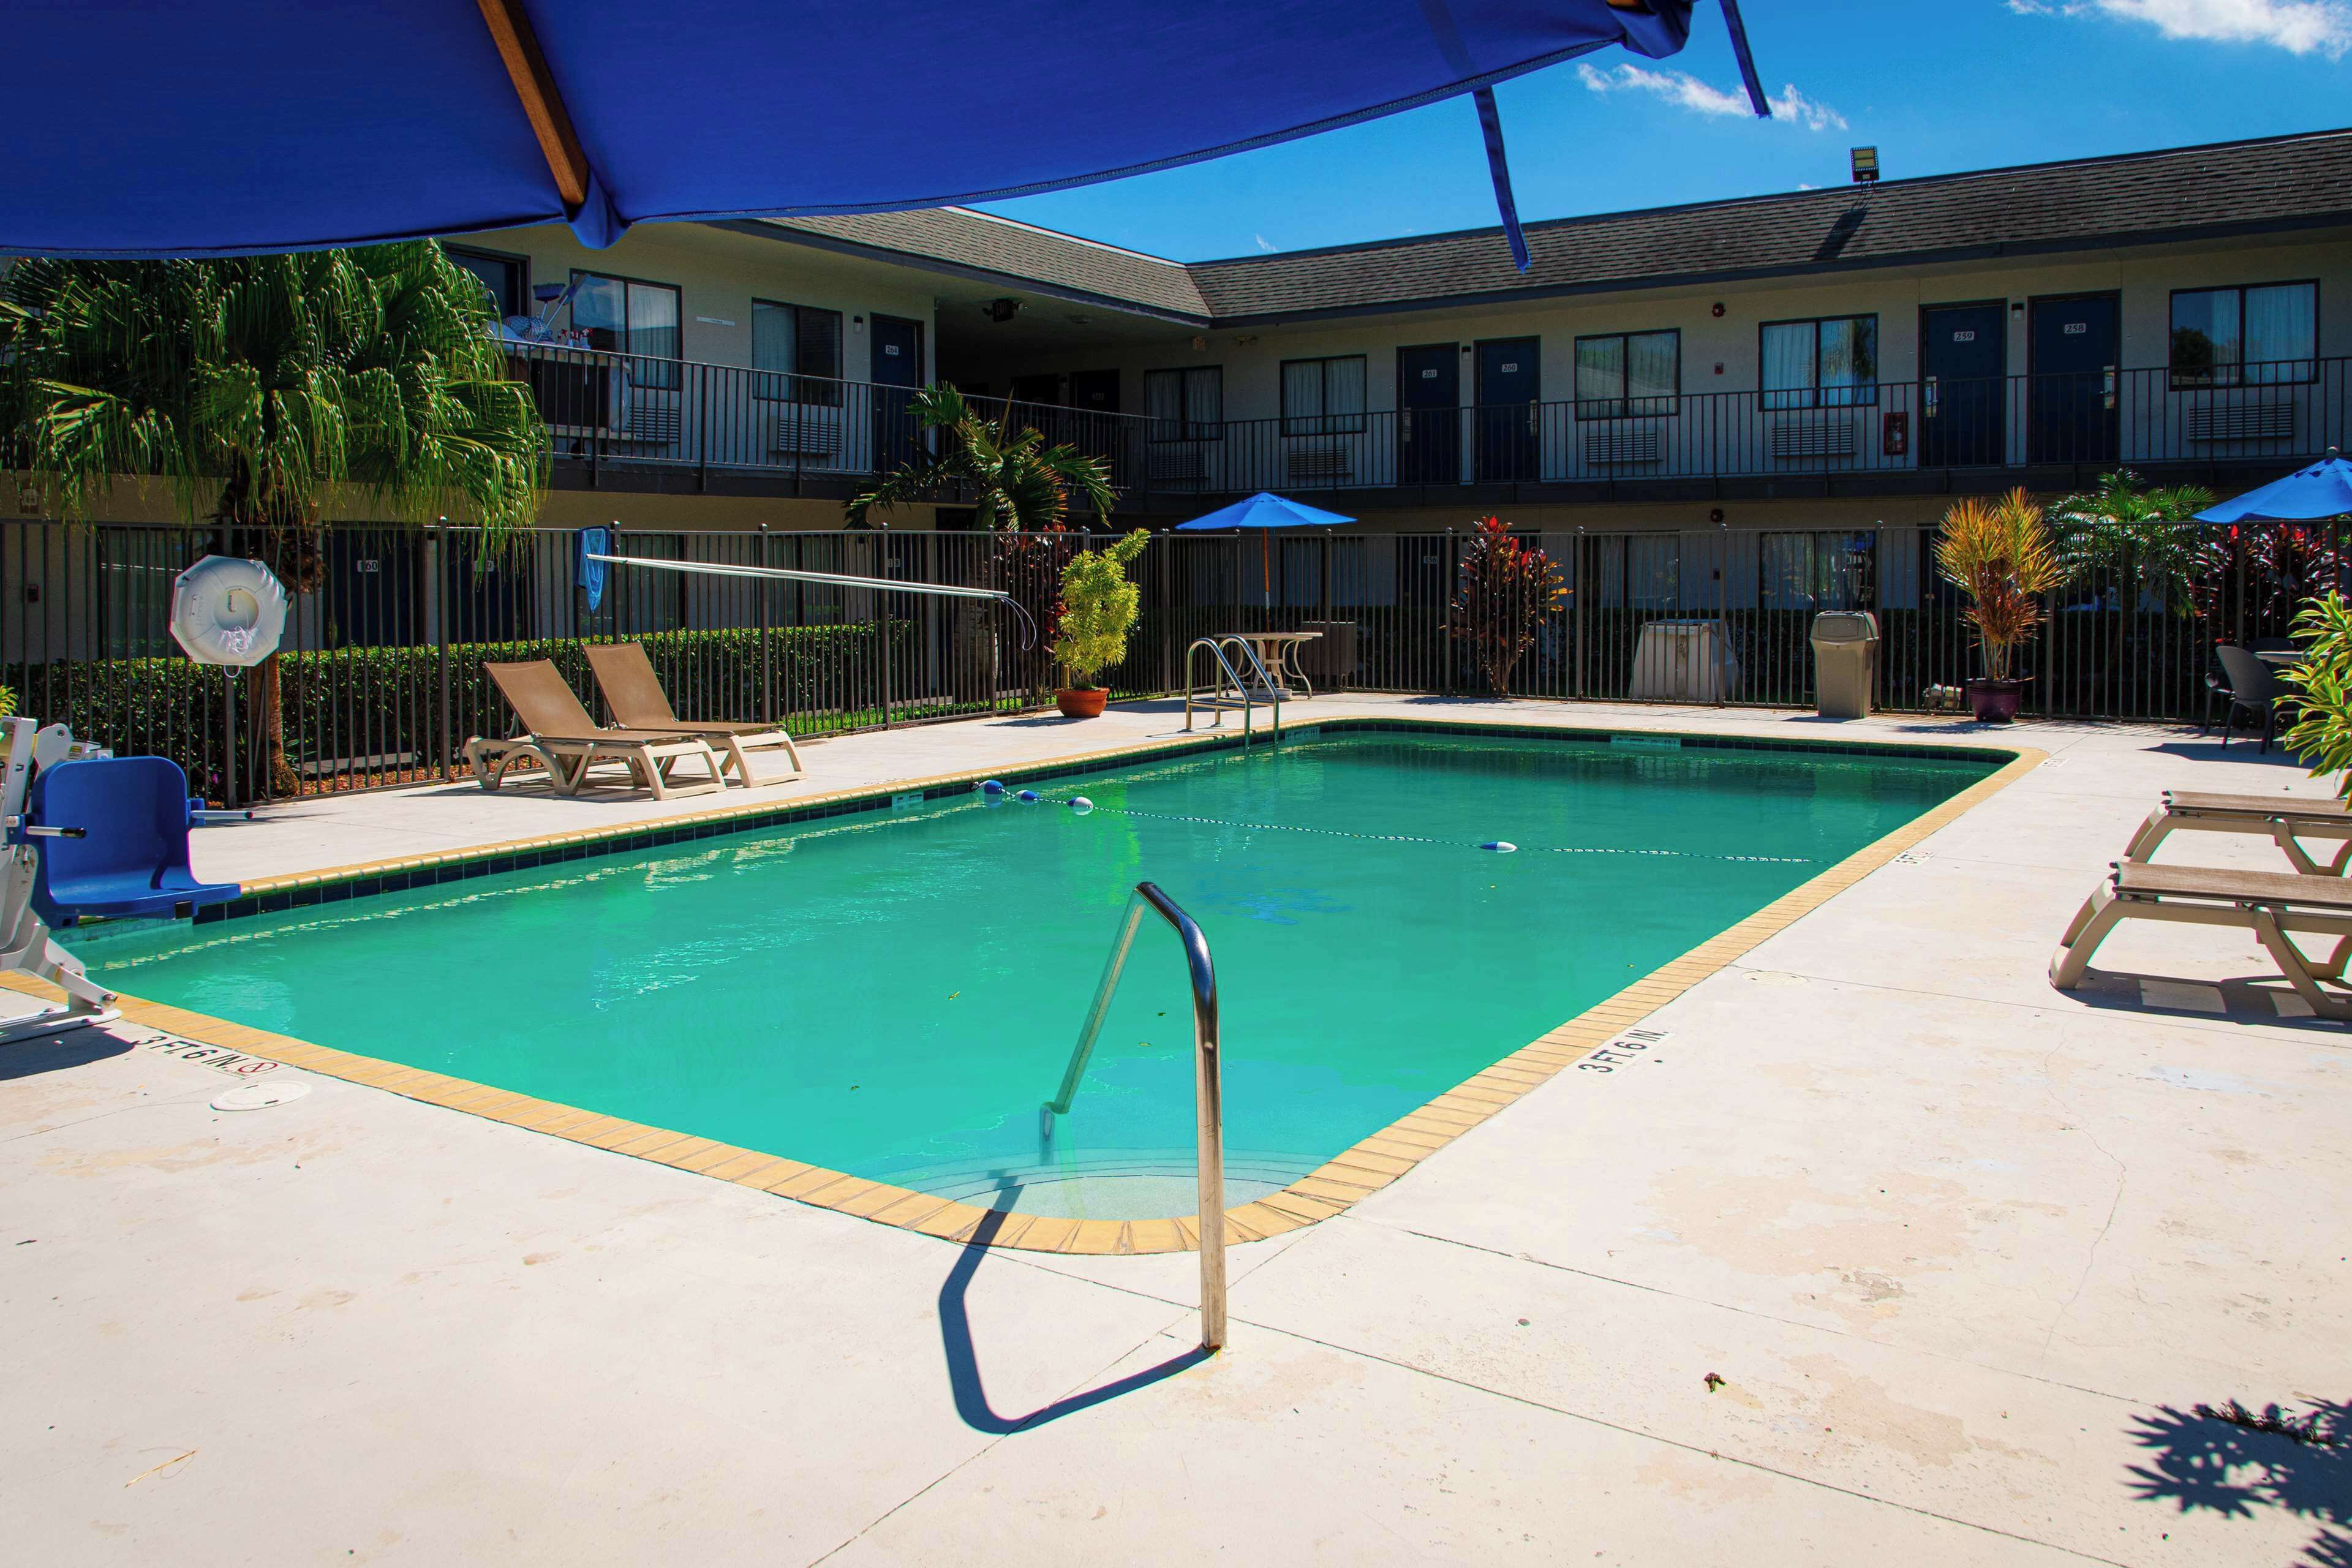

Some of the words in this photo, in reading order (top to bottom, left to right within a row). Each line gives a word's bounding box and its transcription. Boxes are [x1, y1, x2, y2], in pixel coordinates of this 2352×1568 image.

[133, 1036, 168, 1045] 3
[1624, 1030, 1669, 1042] IN.
[149, 1041, 202, 1054] FT.
[1613, 1041, 1648, 1050] 6
[181, 1049, 219, 1059] 6
[1589, 1049, 1636, 1065] FT.
[200, 1054, 250, 1068] IN.
[1577, 1064, 1613, 1073] 3
